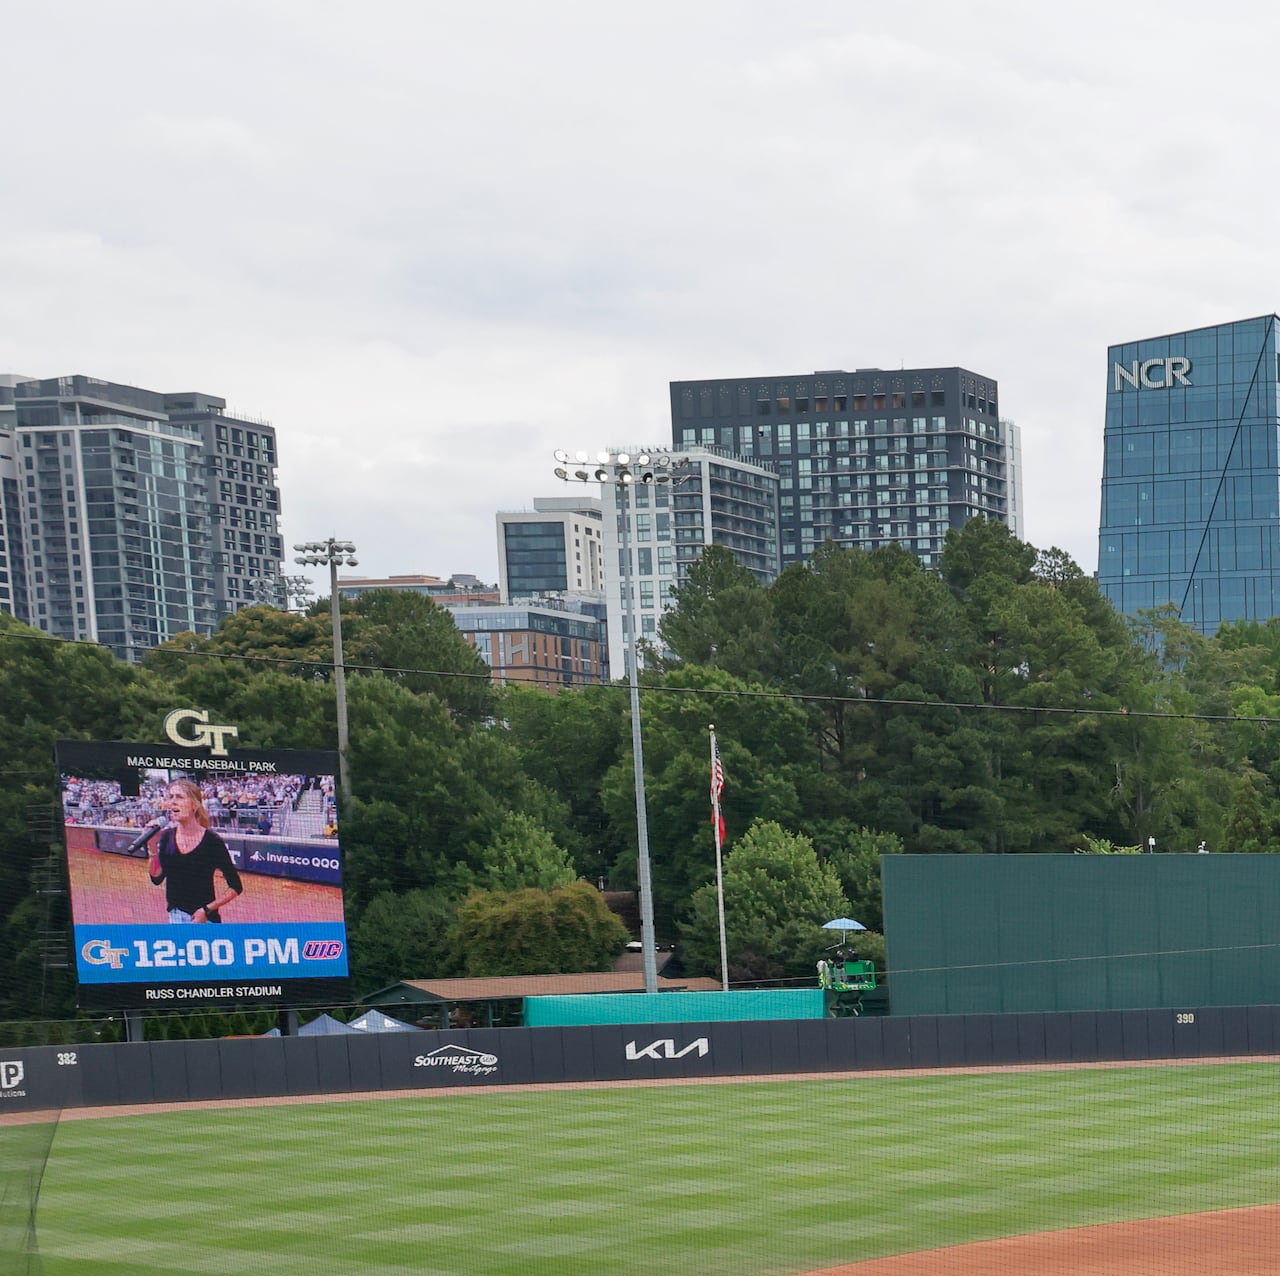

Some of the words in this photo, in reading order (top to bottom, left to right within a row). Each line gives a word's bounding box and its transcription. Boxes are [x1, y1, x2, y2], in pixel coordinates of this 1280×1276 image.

[1114, 356, 1193, 391] NCR
[164, 708, 238, 756] GT
[127, 756, 154, 768] MAC
[156, 757, 191, 769] NEASE
[193, 758, 247, 771] BASEBALL
[249, 761, 277, 772] PARK
[266, 851, 311, 866] Invesco
[311, 857, 340, 870] QQQ
[81, 940, 129, 968] GT
[133, 939, 235, 968] 12:00
[244, 938, 299, 965] PM
[303, 941, 343, 959] UIC
[146, 988, 174, 1000] RUSS
[176, 987, 234, 999] CHANDLER
[235, 985, 282, 998] STADIUM
[1176, 1013, 1195, 1024] 390
[413, 1055, 480, 1067] SOUTHEAST
